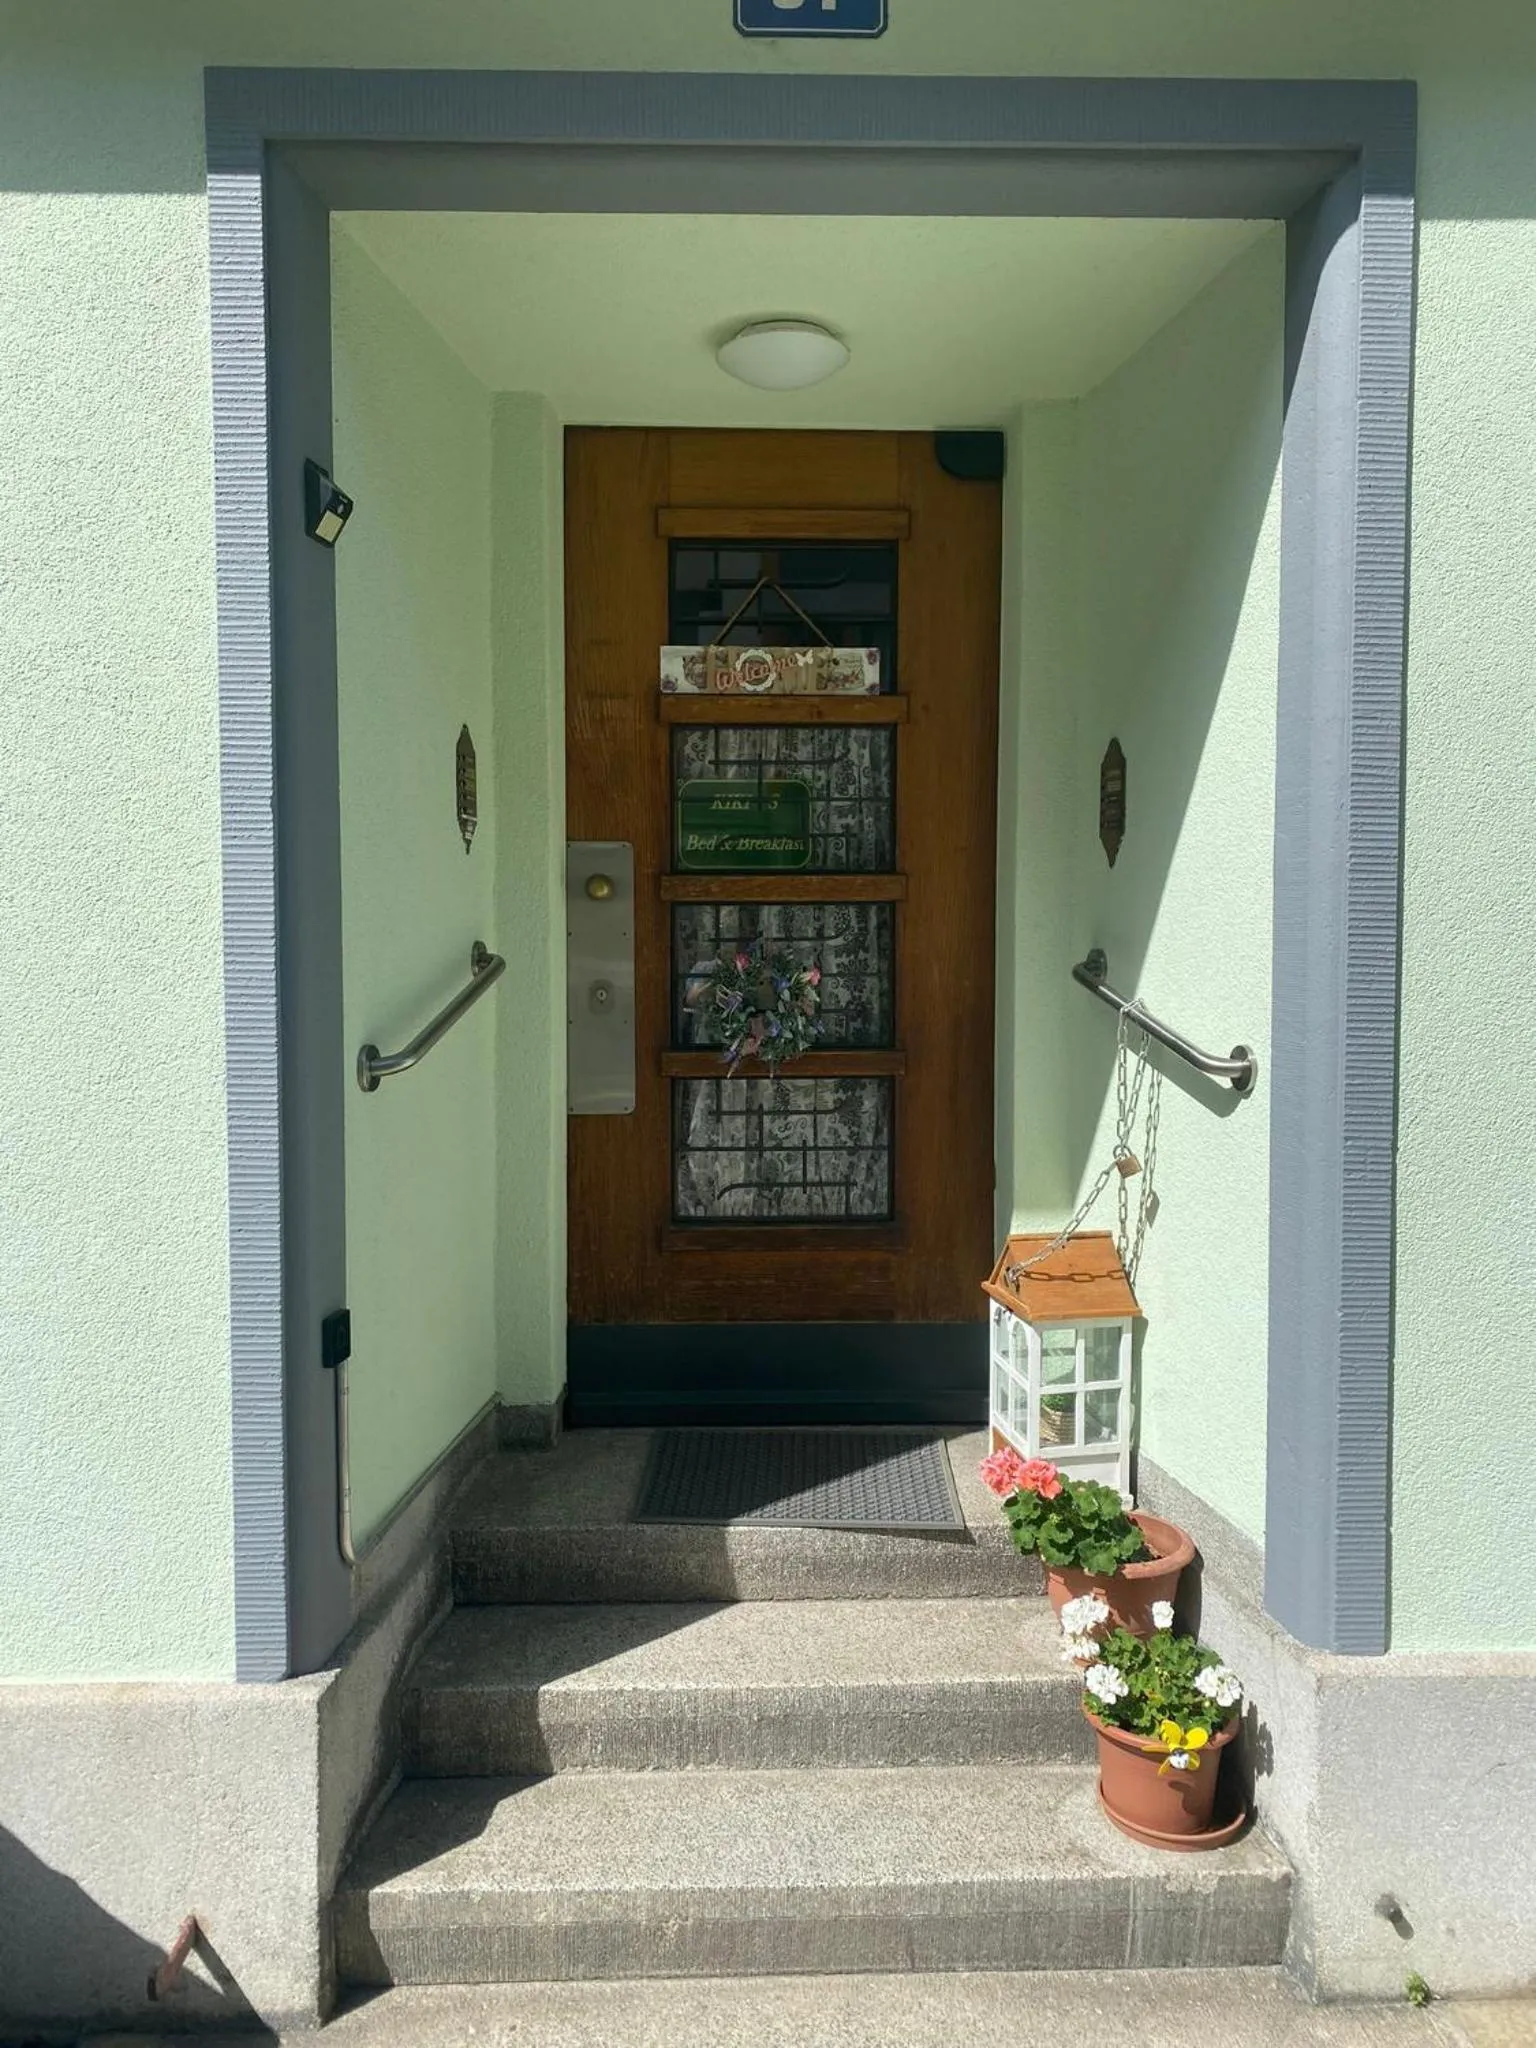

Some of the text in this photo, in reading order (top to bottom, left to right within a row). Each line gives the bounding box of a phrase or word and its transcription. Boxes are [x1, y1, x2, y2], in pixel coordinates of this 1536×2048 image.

[716, 655, 798, 691] Welcome
[686, 834, 717, 851] Bed
[736, 835, 805, 851] Breakfast
